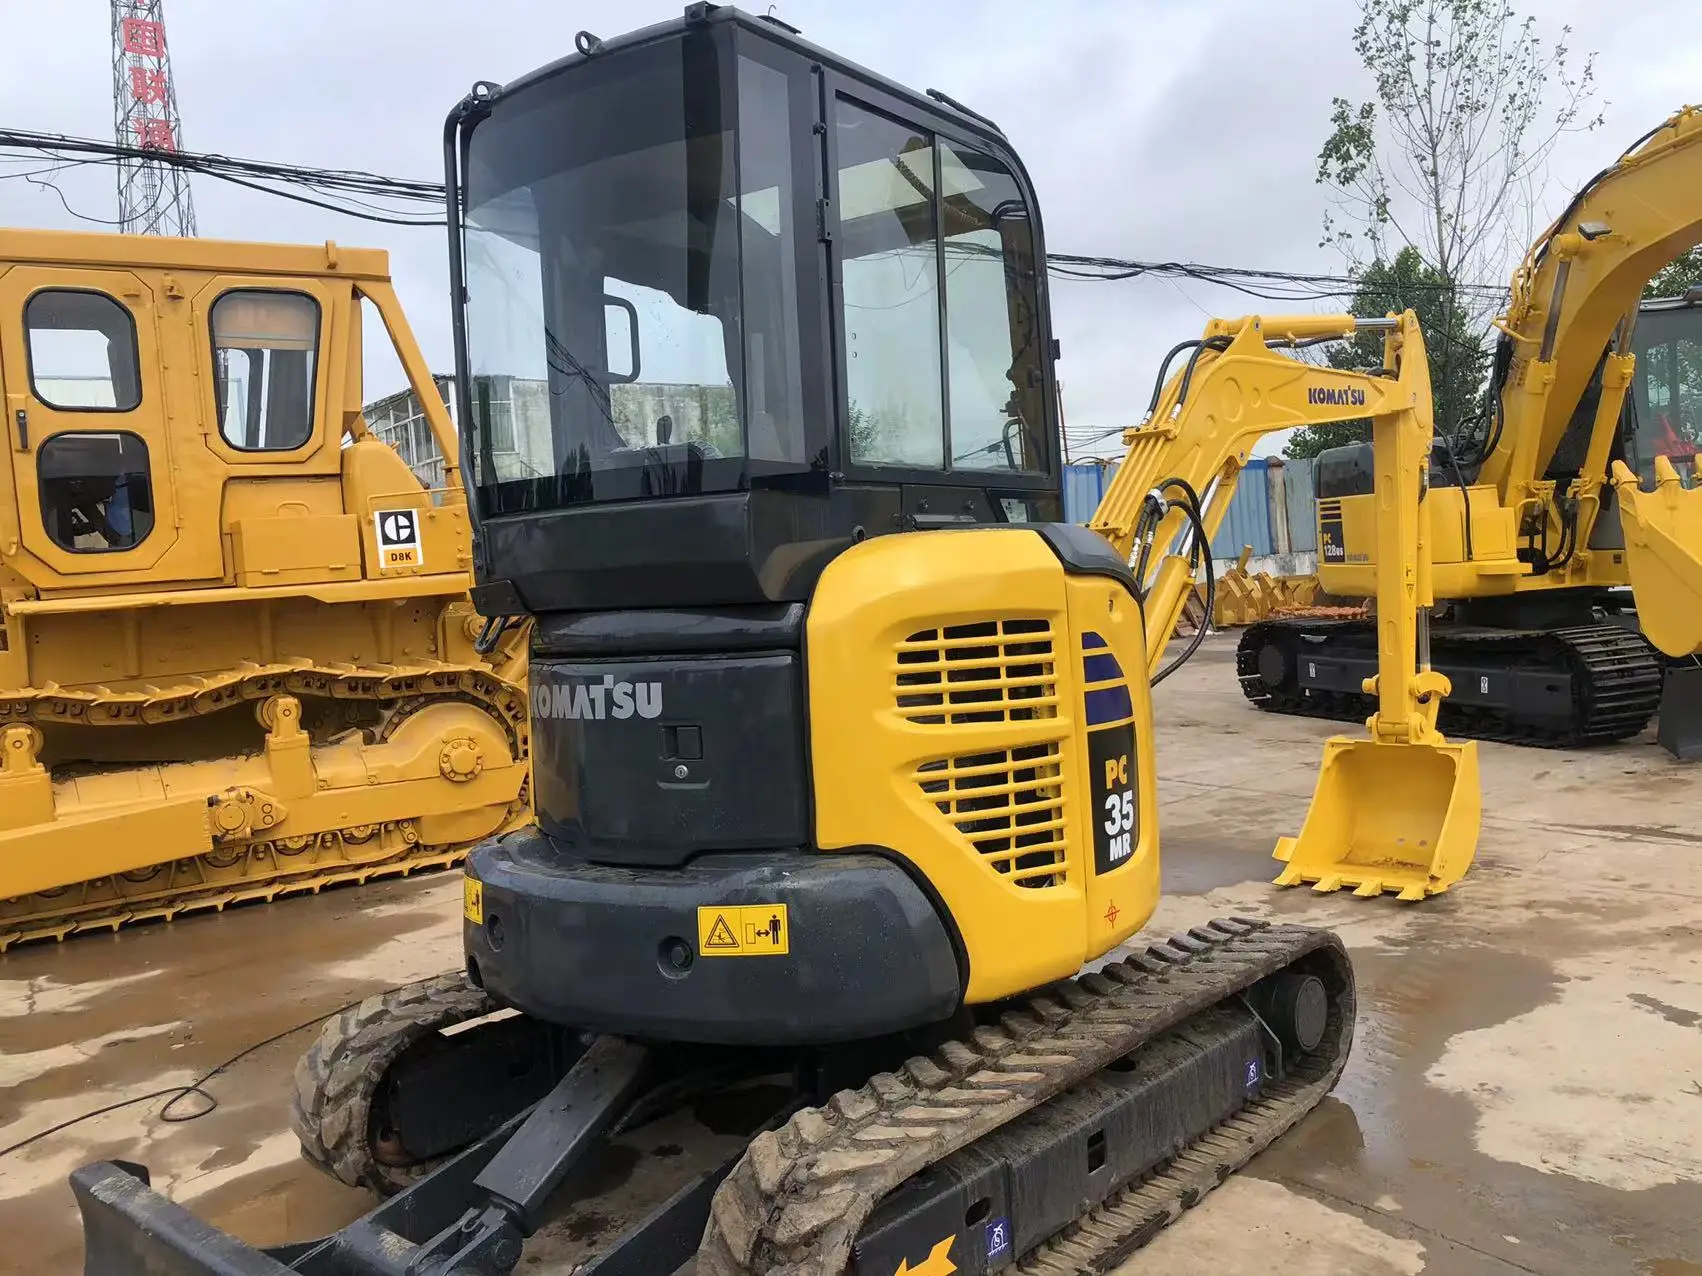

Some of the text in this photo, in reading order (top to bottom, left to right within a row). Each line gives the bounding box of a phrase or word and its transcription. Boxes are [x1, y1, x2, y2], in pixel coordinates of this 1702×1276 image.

[122, 0, 176, 155] 国联通
[1308, 385, 1365, 405] KOMATSU
[1323, 533, 1332, 544] PC
[391, 552, 412, 561] D8K
[529, 674, 663, 719] KOMATSU
[1105, 755, 1128, 789] PC
[1104, 790, 1134, 835] 35
[1109, 833, 1131, 861] MR
